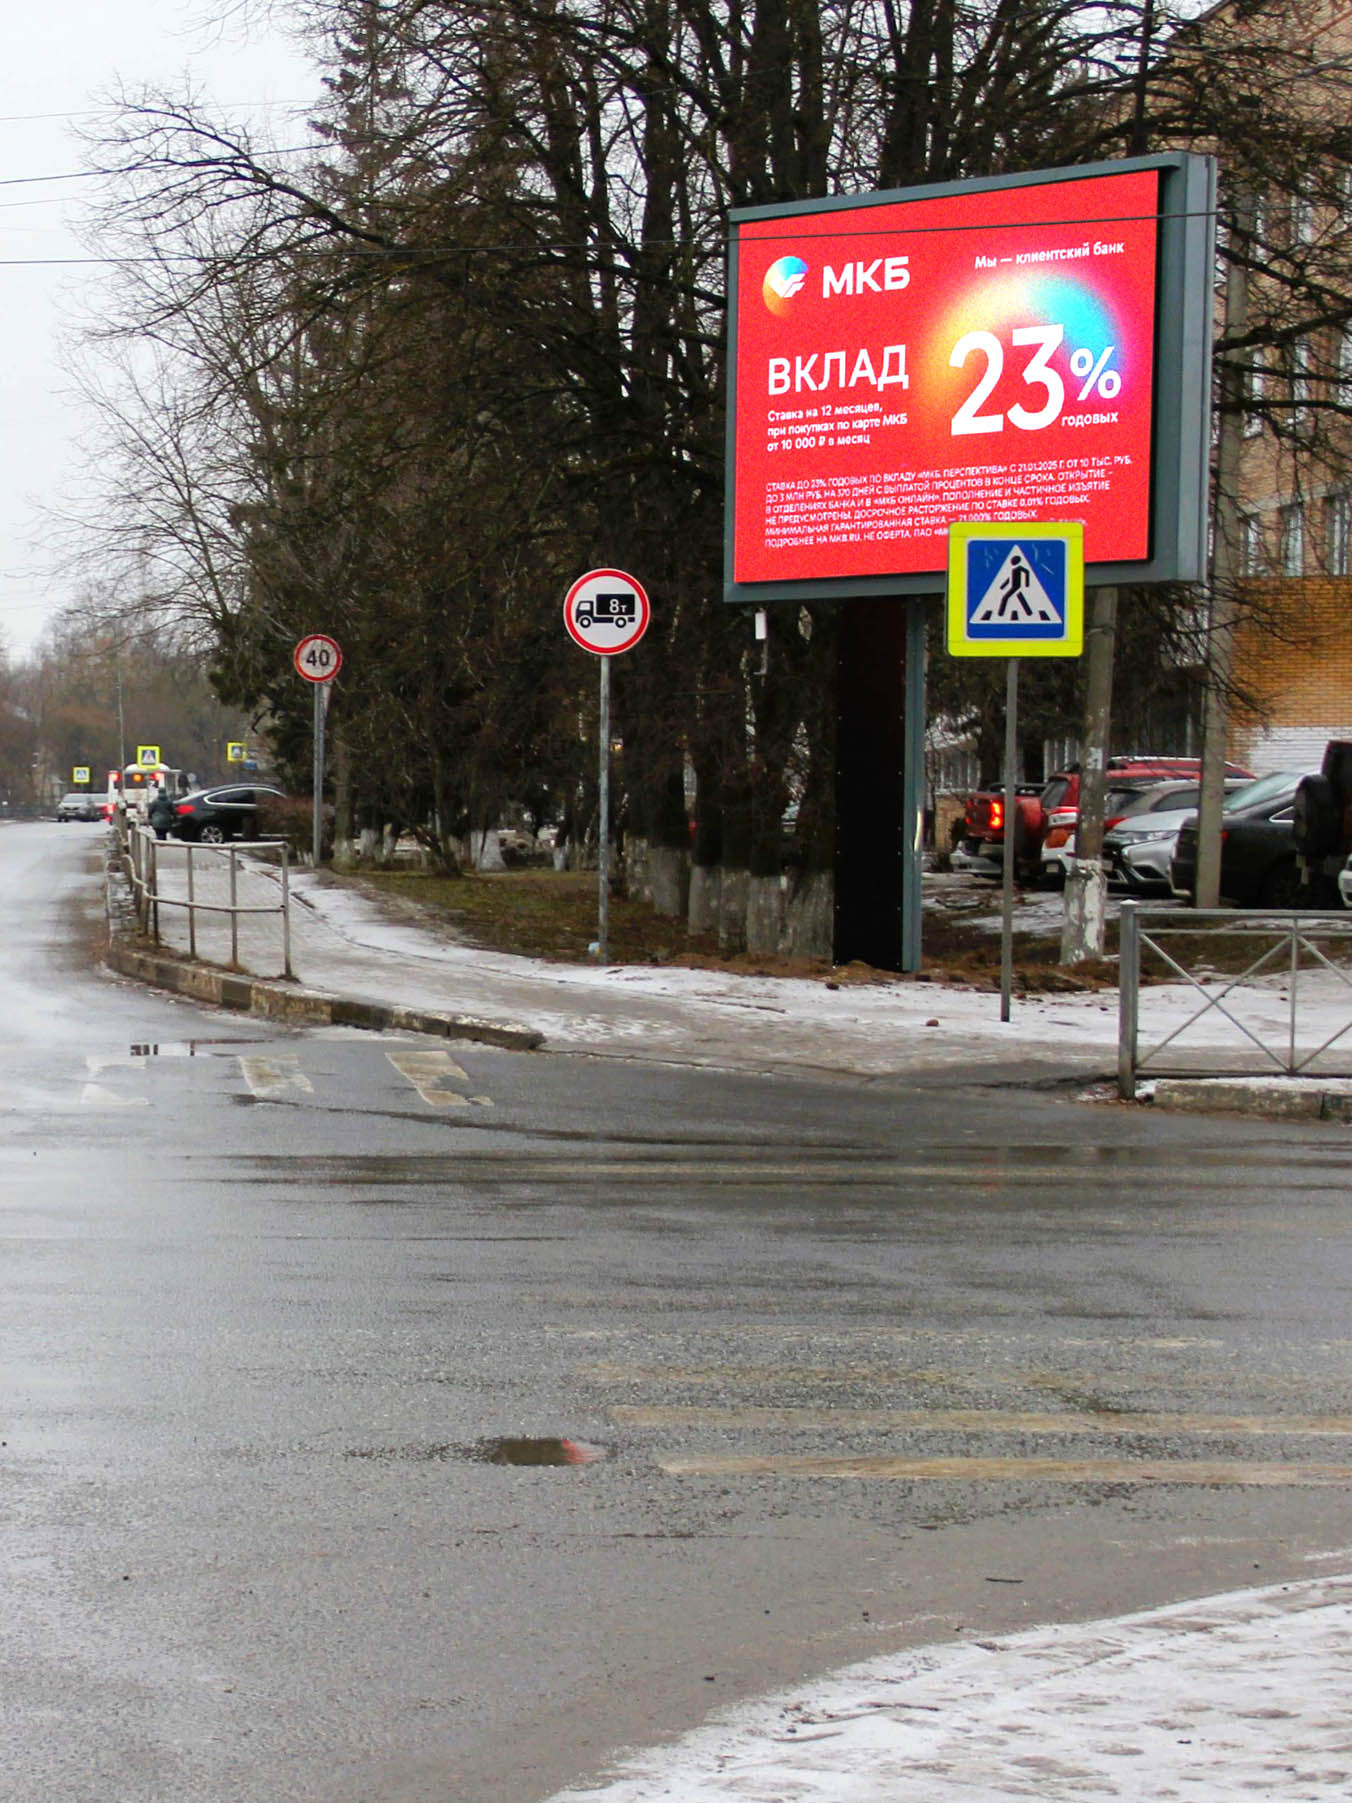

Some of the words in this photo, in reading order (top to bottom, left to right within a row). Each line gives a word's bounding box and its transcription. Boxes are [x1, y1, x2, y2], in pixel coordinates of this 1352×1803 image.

[975, 256, 997, 269] Мы
[1016, 243, 1090, 264] клиентский
[1093, 241, 1125, 256] банк
[822, 256, 911, 298] МКБ
[768, 344, 909, 395] ВКЛАД
[949, 324, 1122, 435] 23%
[768, 410, 804, 421] Ставка
[806, 408, 818, 417] на
[821, 405, 832, 416] 12
[834, 402, 883, 416] месяцев,
[1061, 412, 1119, 428] годовых
[767, 427, 786, 439] при
[788, 421, 835, 435] покупках
[837, 421, 850, 430] по
[852, 418, 881, 430] карте
[882, 413, 908, 426] МКБ
[767, 442, 779, 452] от
[781, 439, 793, 450] 10
[795, 436, 816, 449] 000
[828, 437, 835, 446] в
[837, 433, 870, 445] месяц
[765, 494, 778, 504] ДО
[823, 489, 836, 499] НА
[852, 485, 875, 498] ДНЕЙ
[876, 485, 883, 495] С
[884, 480, 930, 495] ВЫПЛАТОЙ
[932, 475, 984, 490] ПРОЦЕНТОВ
[985, 476, 992, 486] В
[993, 474, 1023, 486] КОНЦЕ
[1057, 468, 1106, 481] ОТКРЫТИЕ
[766, 482, 795, 492] СТАВКА
[797, 480, 810, 490] ДО
[828, 477, 867, 488] ГОДОВЫХ
[869, 475, 882, 484] ПО
[883, 472, 916, 483] ВКЛАДУ
[1066, 459, 1079, 468] ОТ
[772, 499, 827, 513] ОТДЕЛЕНИЯХ
[828, 497, 856, 509] БАНКА
[857, 497, 865, 506] И
[865, 497, 872, 507] В
[942, 489, 1004, 502] ПОПОЛНЕНИЕ
[1004, 488, 1012, 497] И
[1013, 484, 1068, 496] ЧАСТИЧНОЕ
[1068, 481, 1111, 492] ИЗЪЯТИЕ
[765, 516, 777, 526] НЕ
[853, 507, 907, 520] ДОСРОЧНОЕ
[908, 503, 970, 517] РАСТОРЖЕНИЕ
[971, 501, 985, 511] ПО
[986, 499, 1019, 510] СТАВКЕ
[830, 517, 913, 532] ГАРАНТИРОВАННАЯ
[914, 516, 947, 526] СТАВКА
[765, 535, 815, 548] ПОДРОБНЕЕ
[816, 535, 828, 544] НА
[863, 532, 875, 542] НЕ
[306, 649, 330, 667] 40
